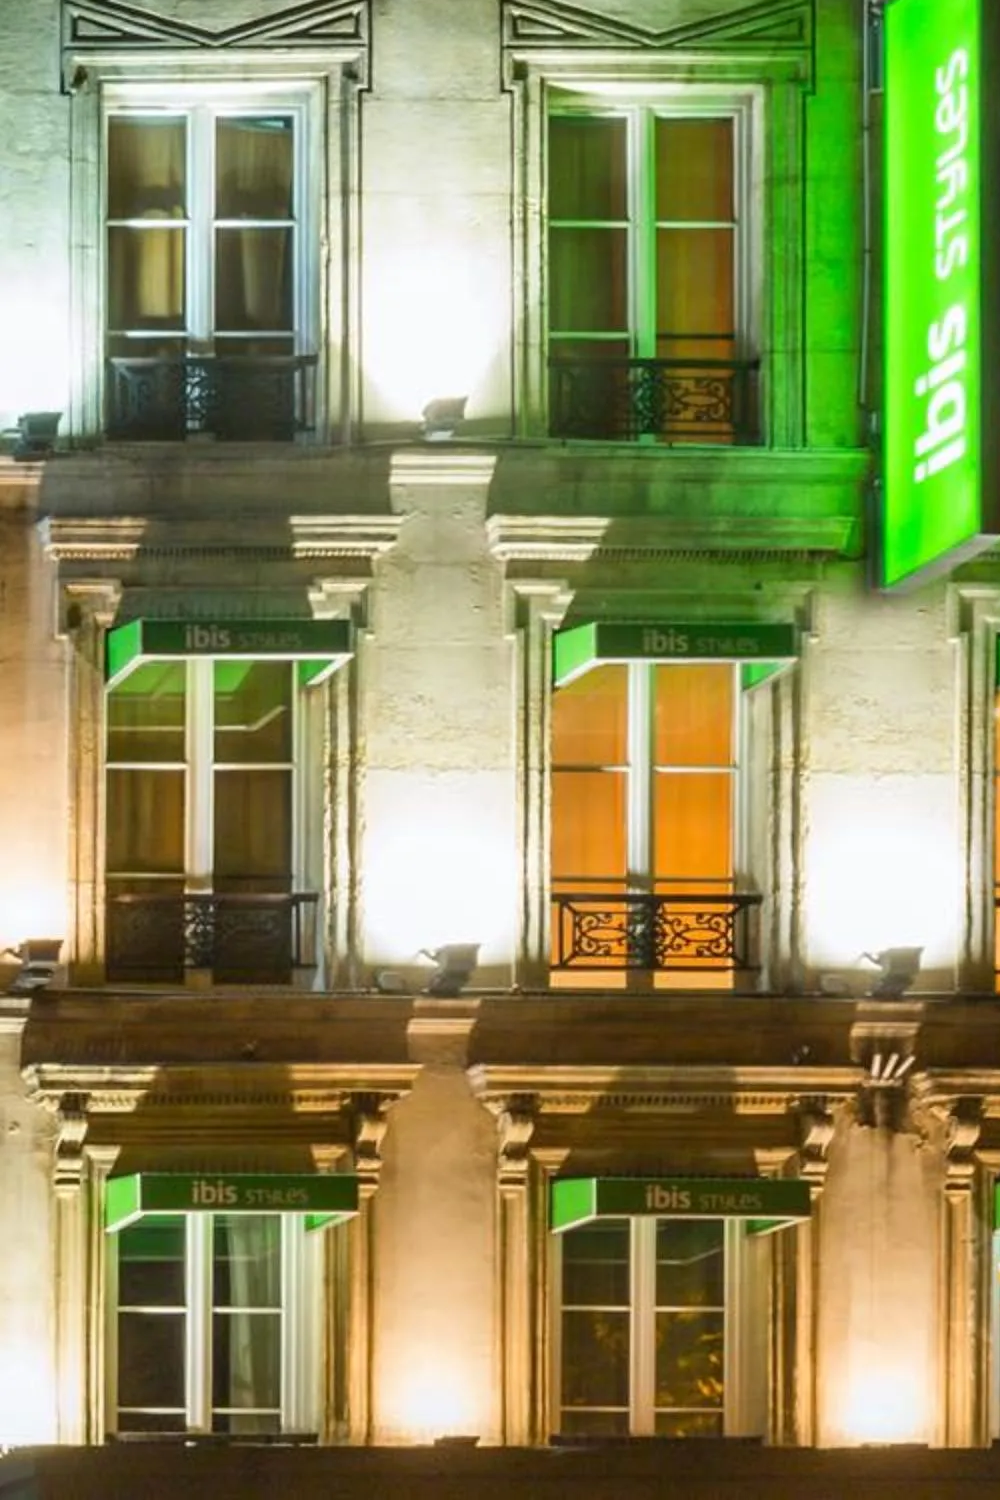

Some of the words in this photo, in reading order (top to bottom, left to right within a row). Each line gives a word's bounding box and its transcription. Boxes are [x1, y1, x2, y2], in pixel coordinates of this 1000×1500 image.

[915, 303, 968, 483] ibis
[184, 625, 231, 649] ibis
[643, 629, 688, 653] ibis
[192, 1180, 238, 1204] ibis
[646, 1185, 691, 1209] ibis
